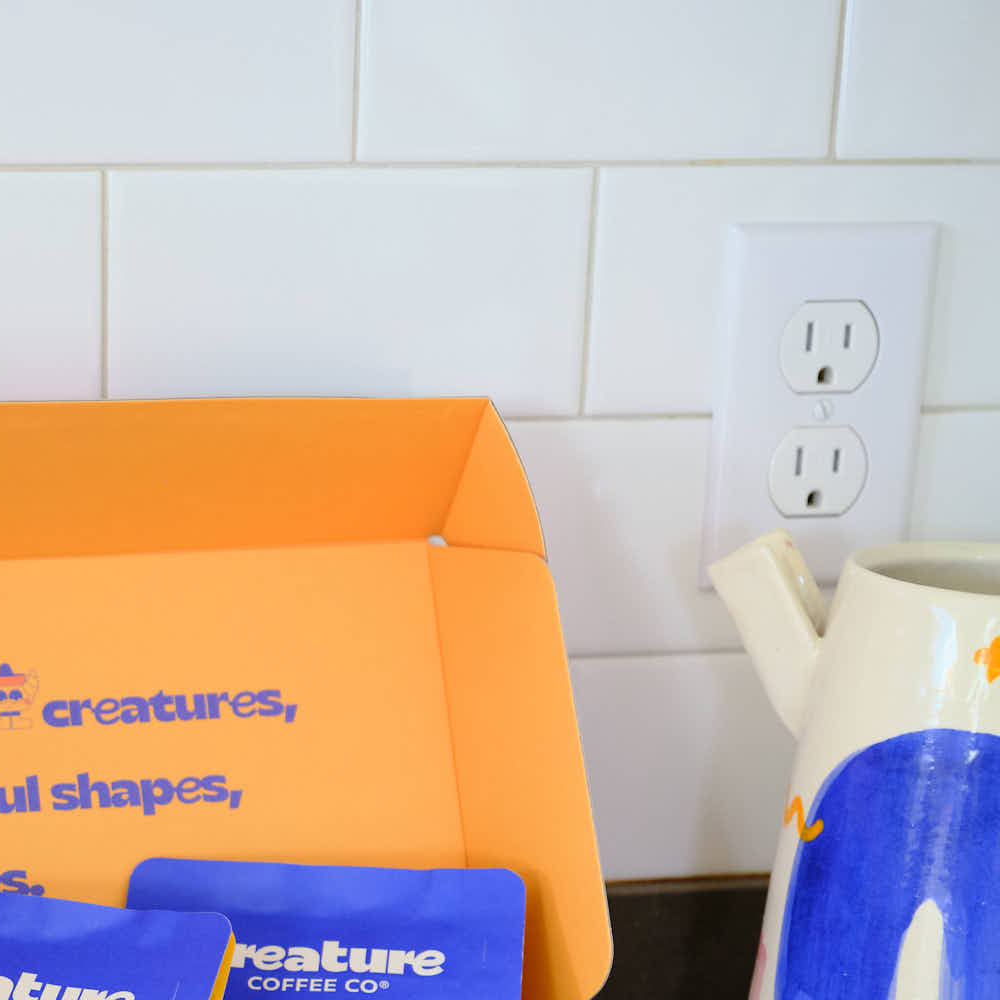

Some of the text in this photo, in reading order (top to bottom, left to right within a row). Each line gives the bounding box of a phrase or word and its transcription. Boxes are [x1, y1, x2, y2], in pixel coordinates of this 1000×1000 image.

[42, 689, 298, 728] creatures,
[50, 772, 243, 816] shapes,
[231, 940, 447, 976] reature
[248, 976, 338, 992] COFFEE
